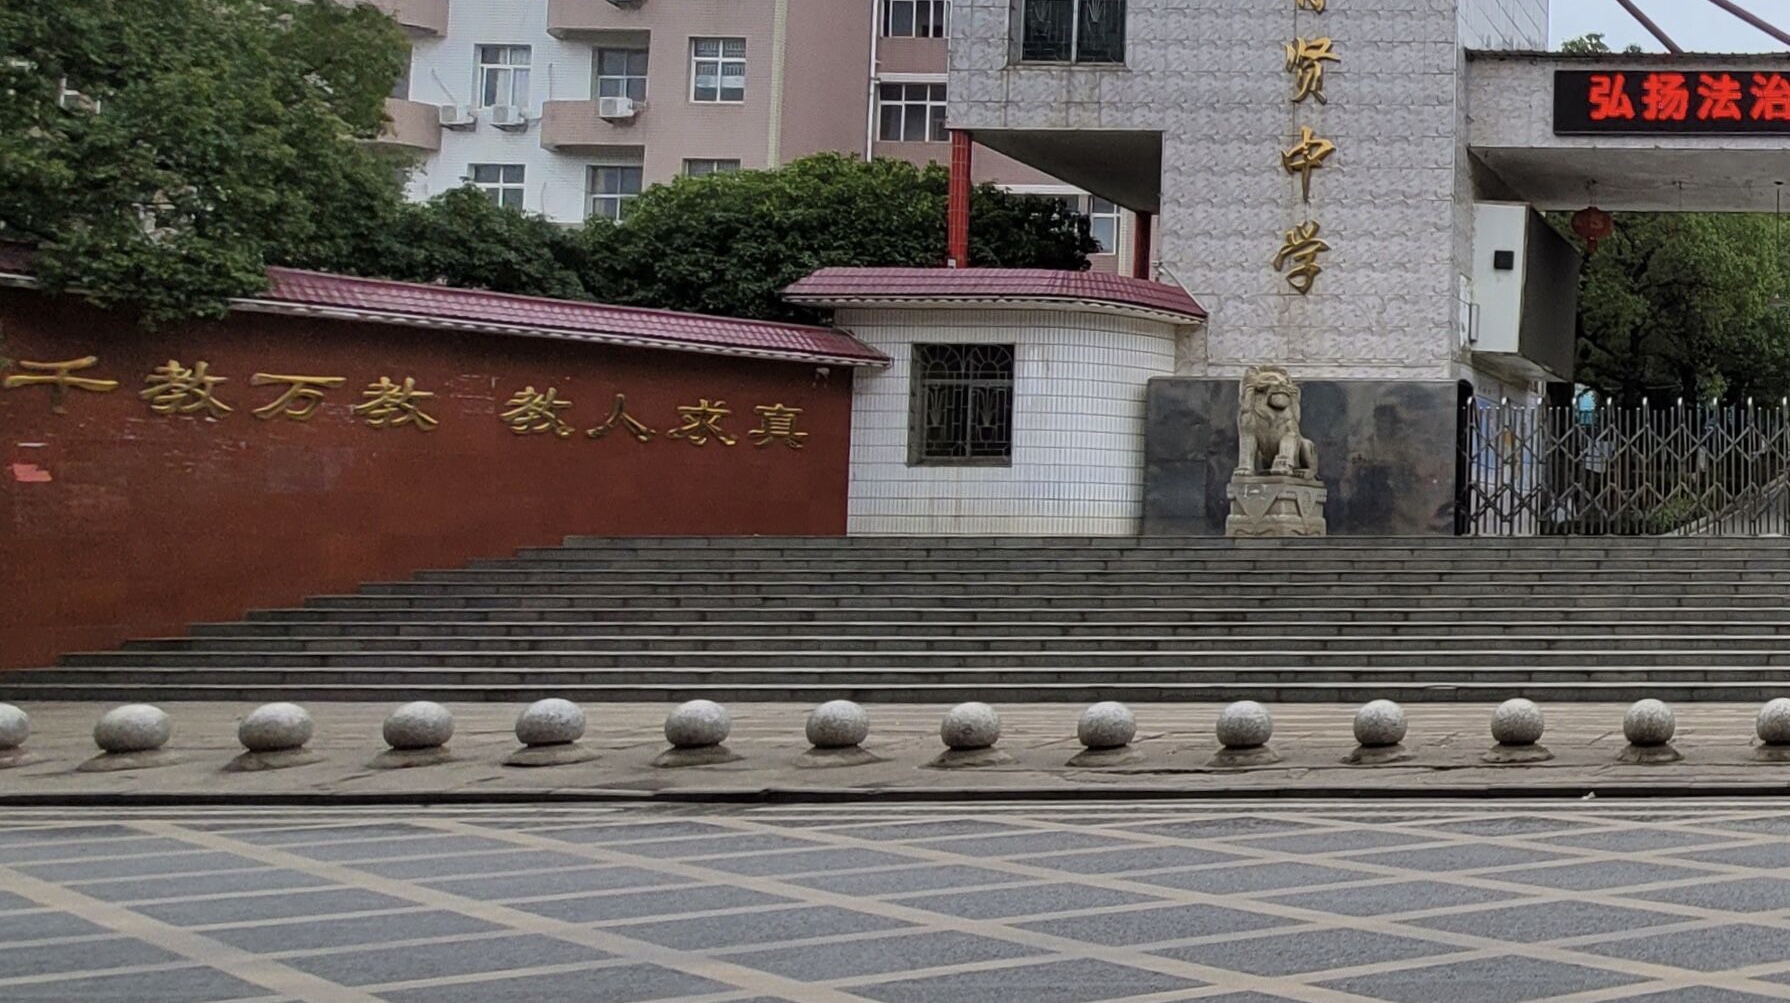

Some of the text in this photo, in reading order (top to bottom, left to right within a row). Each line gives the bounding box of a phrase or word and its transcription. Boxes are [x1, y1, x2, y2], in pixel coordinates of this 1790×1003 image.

[3, 357, 806, 447] 千教万教 教人求真
